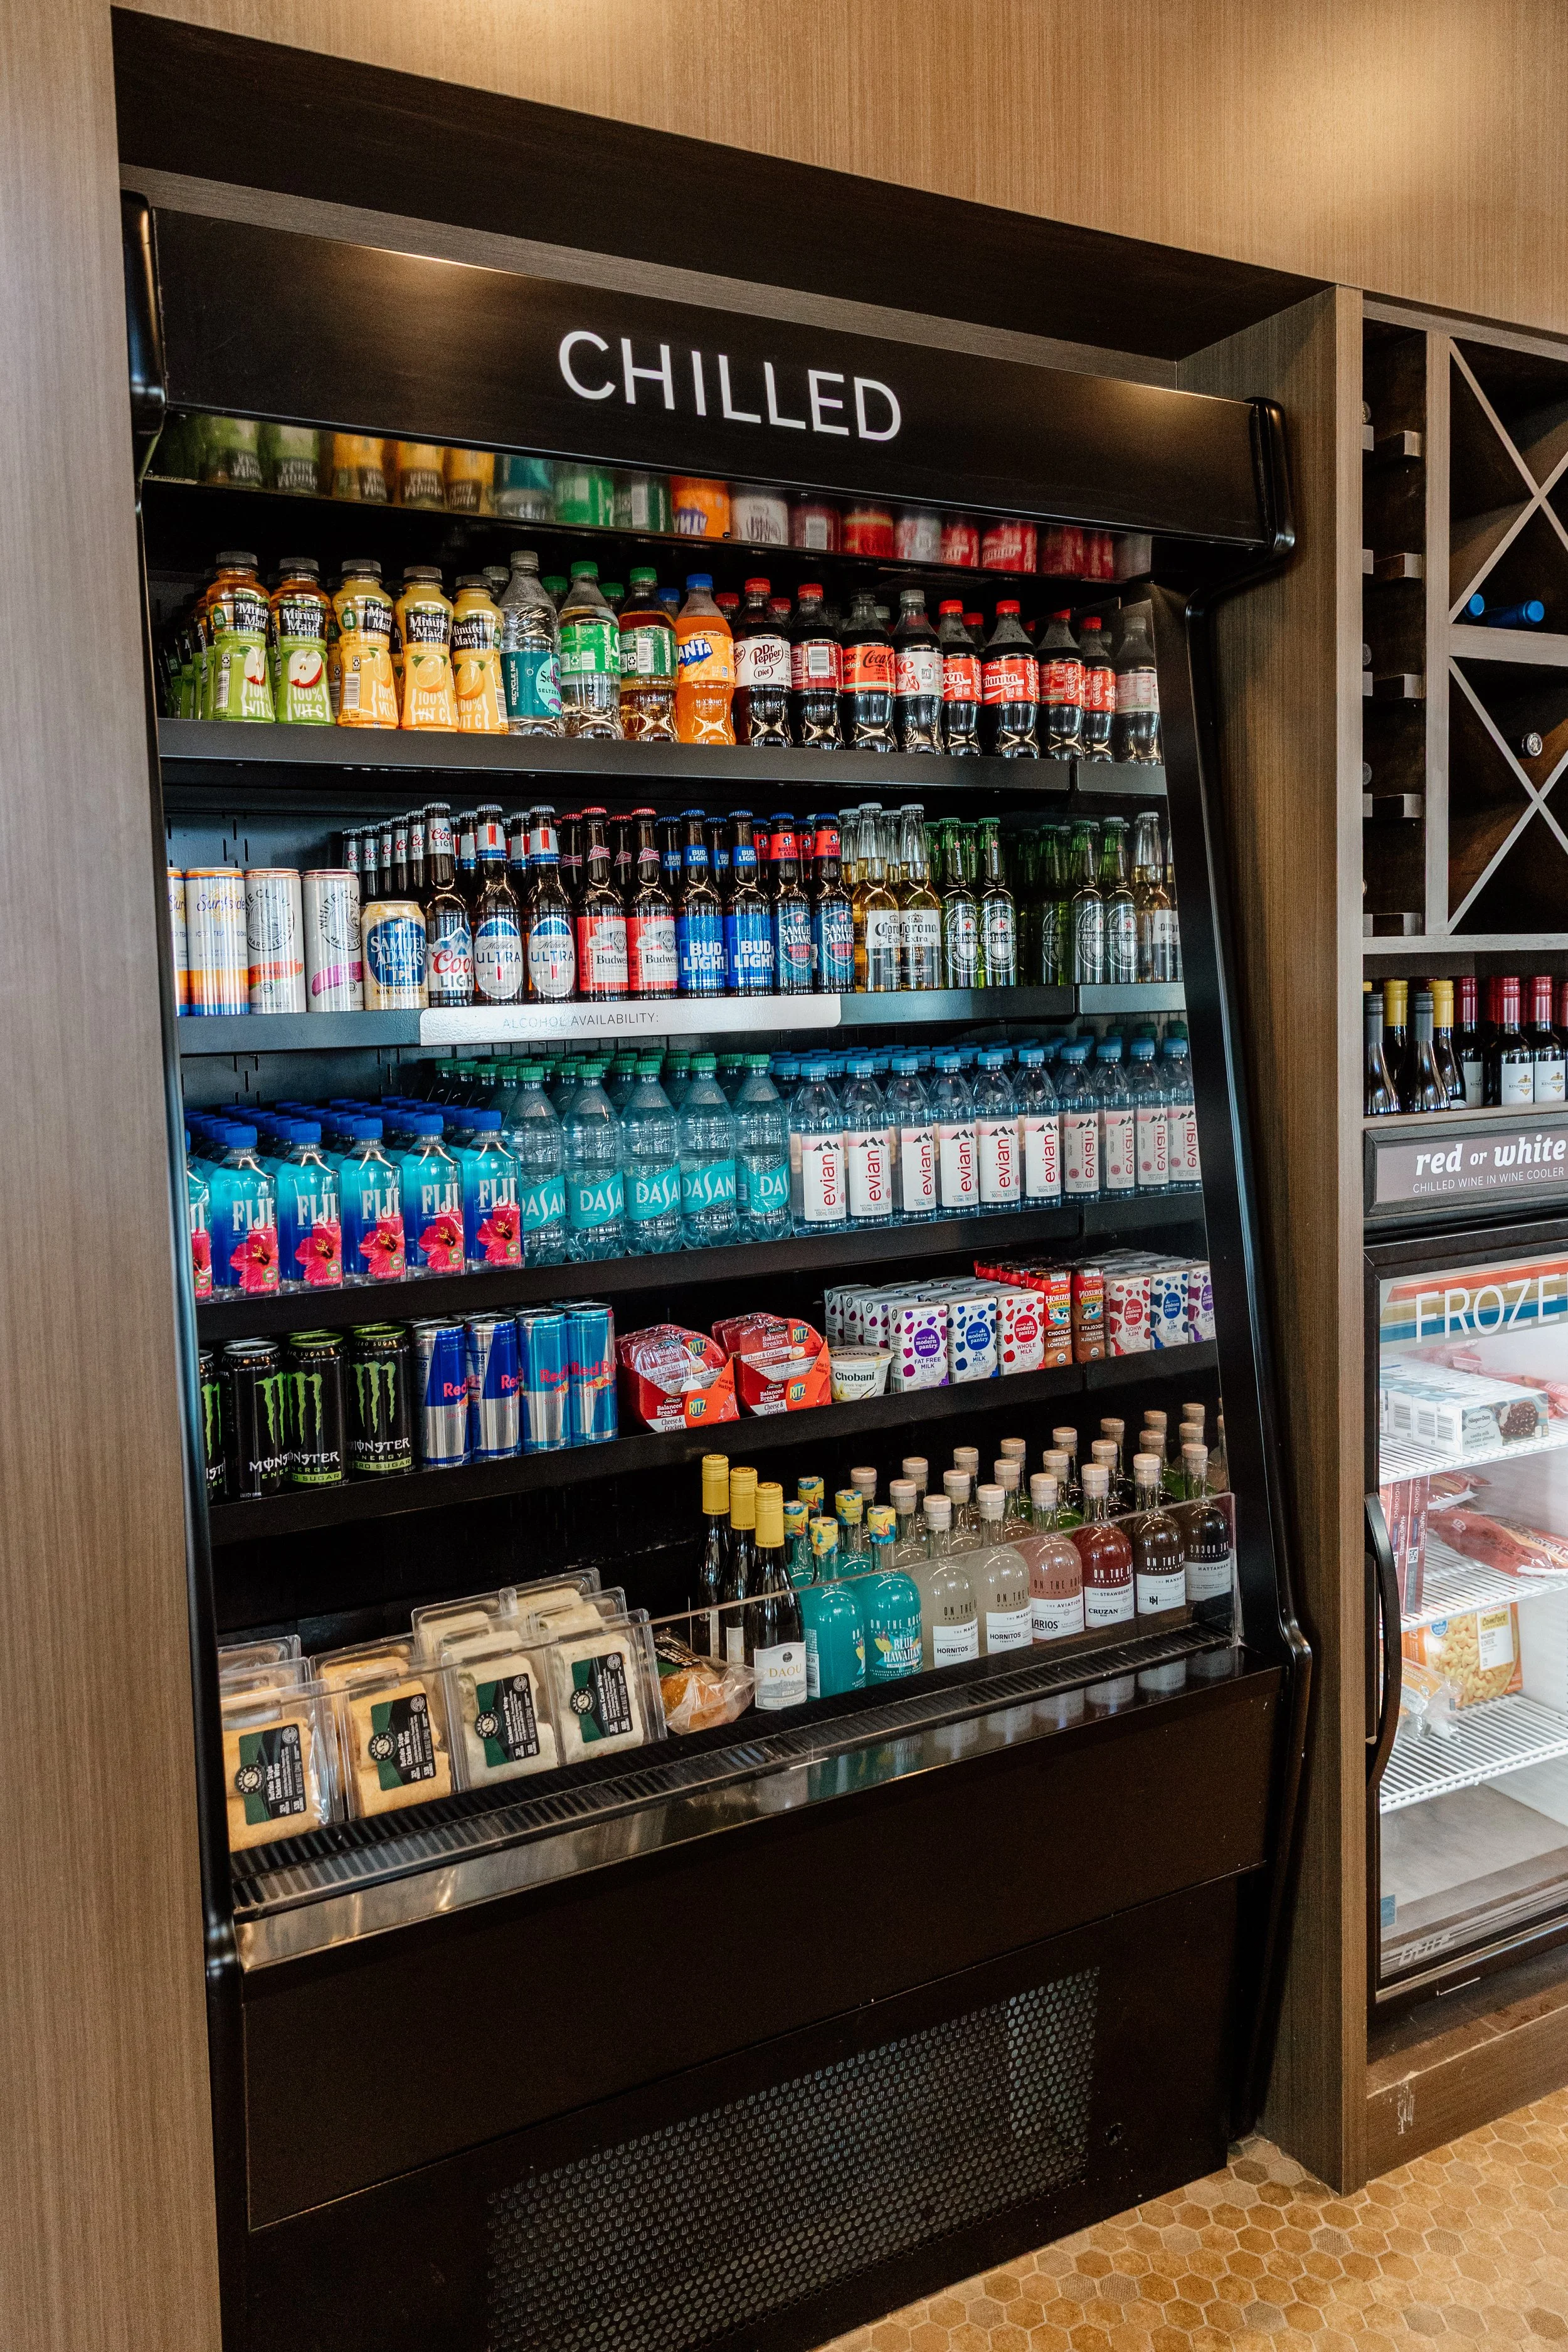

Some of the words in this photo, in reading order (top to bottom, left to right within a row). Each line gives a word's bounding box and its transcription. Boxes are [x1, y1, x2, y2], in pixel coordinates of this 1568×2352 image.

[558, 331, 902, 441] CHILLED
[238, 602, 268, 618] Minute
[283, 608, 323, 623] Minute
[288, 620, 319, 632] Maid
[410, 617, 448, 630] Minute
[416, 627, 443, 639] Maid
[455, 634, 479, 647] Maid
[678, 639, 712, 662] ANTA
[762, 644, 775, 653] Dr
[754, 647, 781, 665] Pepper
[510, 660, 516, 671] ME
[758, 669, 770, 677] Diet
[293, 687, 322, 701] 100%
[418, 691, 446, 705] 100%
[294, 703, 313, 718] VIT
[315, 704, 324, 718] C
[197, 894, 245, 912] Surfside
[317, 893, 340, 931] WHITE
[779, 924, 810, 936] SAMUEL
[822, 923, 854, 935] SAMUEL
[875, 923, 899, 937] Coro
[899, 922, 938, 938] Corona
[248, 936, 267, 948] HARD
[371, 936, 426, 953] SAMUEL
[784, 935, 811, 946] ADAMS
[827, 933, 854, 945] ADAMS
[905, 935, 928, 943] Extra
[980, 933, 1016, 943] Heineken
[690, 942, 722, 956] BUD
[741, 940, 771, 954] BUD
[376, 951, 424, 968] ADAMS
[477, 951, 521, 963] ULTRA
[531, 950, 574, 963] ULTRA
[734, 954, 773, 968] LIGHT
[393, 971, 411, 980] IPA
[376, 987, 425, 995] NON-ALCOHOLIC
[503, 1015, 566, 1029] ALCOHOL
[571, 1012, 659, 1026] AVAILABILITY:
[1042, 1133, 1056, 1183] evian
[1416, 1143, 1463, 1176] red
[1470, 1151, 1487, 1166] or
[1494, 1134, 1566, 1167] white
[919, 1144, 933, 1195] evian
[958, 1142, 973, 1192] evian
[995, 1138, 1010, 1188] evian
[820, 1153, 835, 1206] evian
[866, 1149, 882, 1201] evian
[1413, 1180, 1455, 1194] CHILLED
[1458, 1175, 1484, 1189] WINE
[1486, 1174, 1496, 1184] IN
[1498, 1170, 1524, 1183] WINE
[1527, 1167, 1565, 1180] COOLER
[421, 1183, 459, 1214] FIJI
[479, 1177, 517, 1209] FIJI
[580, 1182, 623, 1218] DASA
[297, 1193, 337, 1225] FIJI
[362, 1187, 400, 1219] FIJI
[232, 1197, 274, 1231] FIJI
[1416, 1273, 1568, 1343] FROZE
[762, 1332, 788, 1342] Balanced
[792, 1327, 810, 1343] RITZ
[688, 1338, 707, 1357] RITZ
[763, 1340, 784, 1348] Breaks
[473, 1353, 485, 1362] 160
[766, 1349, 783, 1357] Crackers
[540, 1367, 565, 1384] Red
[571, 1361, 599, 1377] Red
[835, 1371, 875, 1382] Chobani
[443, 1380, 468, 1398] Red
[760, 1388, 785, 1397] Balanced
[790, 1384, 806, 1401] RITZ
[760, 1394, 780, 1402] Breaks
[657, 1402, 683, 1411] Balanced
[689, 1399, 707, 1418] RITZ
[765, 1402, 779, 1411] Cheese
[661, 1417, 677, 1426] Cheese
[664, 1422, 685, 1432] Crackers
[376, 1459, 411, 1470] SUGAR
[302, 1473, 340, 1483] SUGAR
[1147, 1557, 1157, 1567] ON
[1163, 1555, 1175, 1567] THE
[1094, 1569, 1104, 1579] ON
[1110, 1567, 1123, 1579] THE
[1051, 1579, 1065, 1590] THE
[997, 1594, 1007, 1603] ON
[1100, 1589, 1130, 1597] STRAWBERRY
[1057, 1599, 1081, 1608] AVIATION
[1032, 1618, 1058, 1631] LARIOS
[1482, 1615, 1507, 1626] Comfort
[990, 1631, 1021, 1640] HORNITOS
[894, 1636, 914, 1651] BLUE
[937, 1645, 968, 1654] HORNITOS
[884, 1644, 922, 1663] HAWAIIAN
[769, 1663, 802, 1678] DAOU
[371, 1735, 380, 1760] MARKET
[238, 1767, 247, 1793] MARKET
